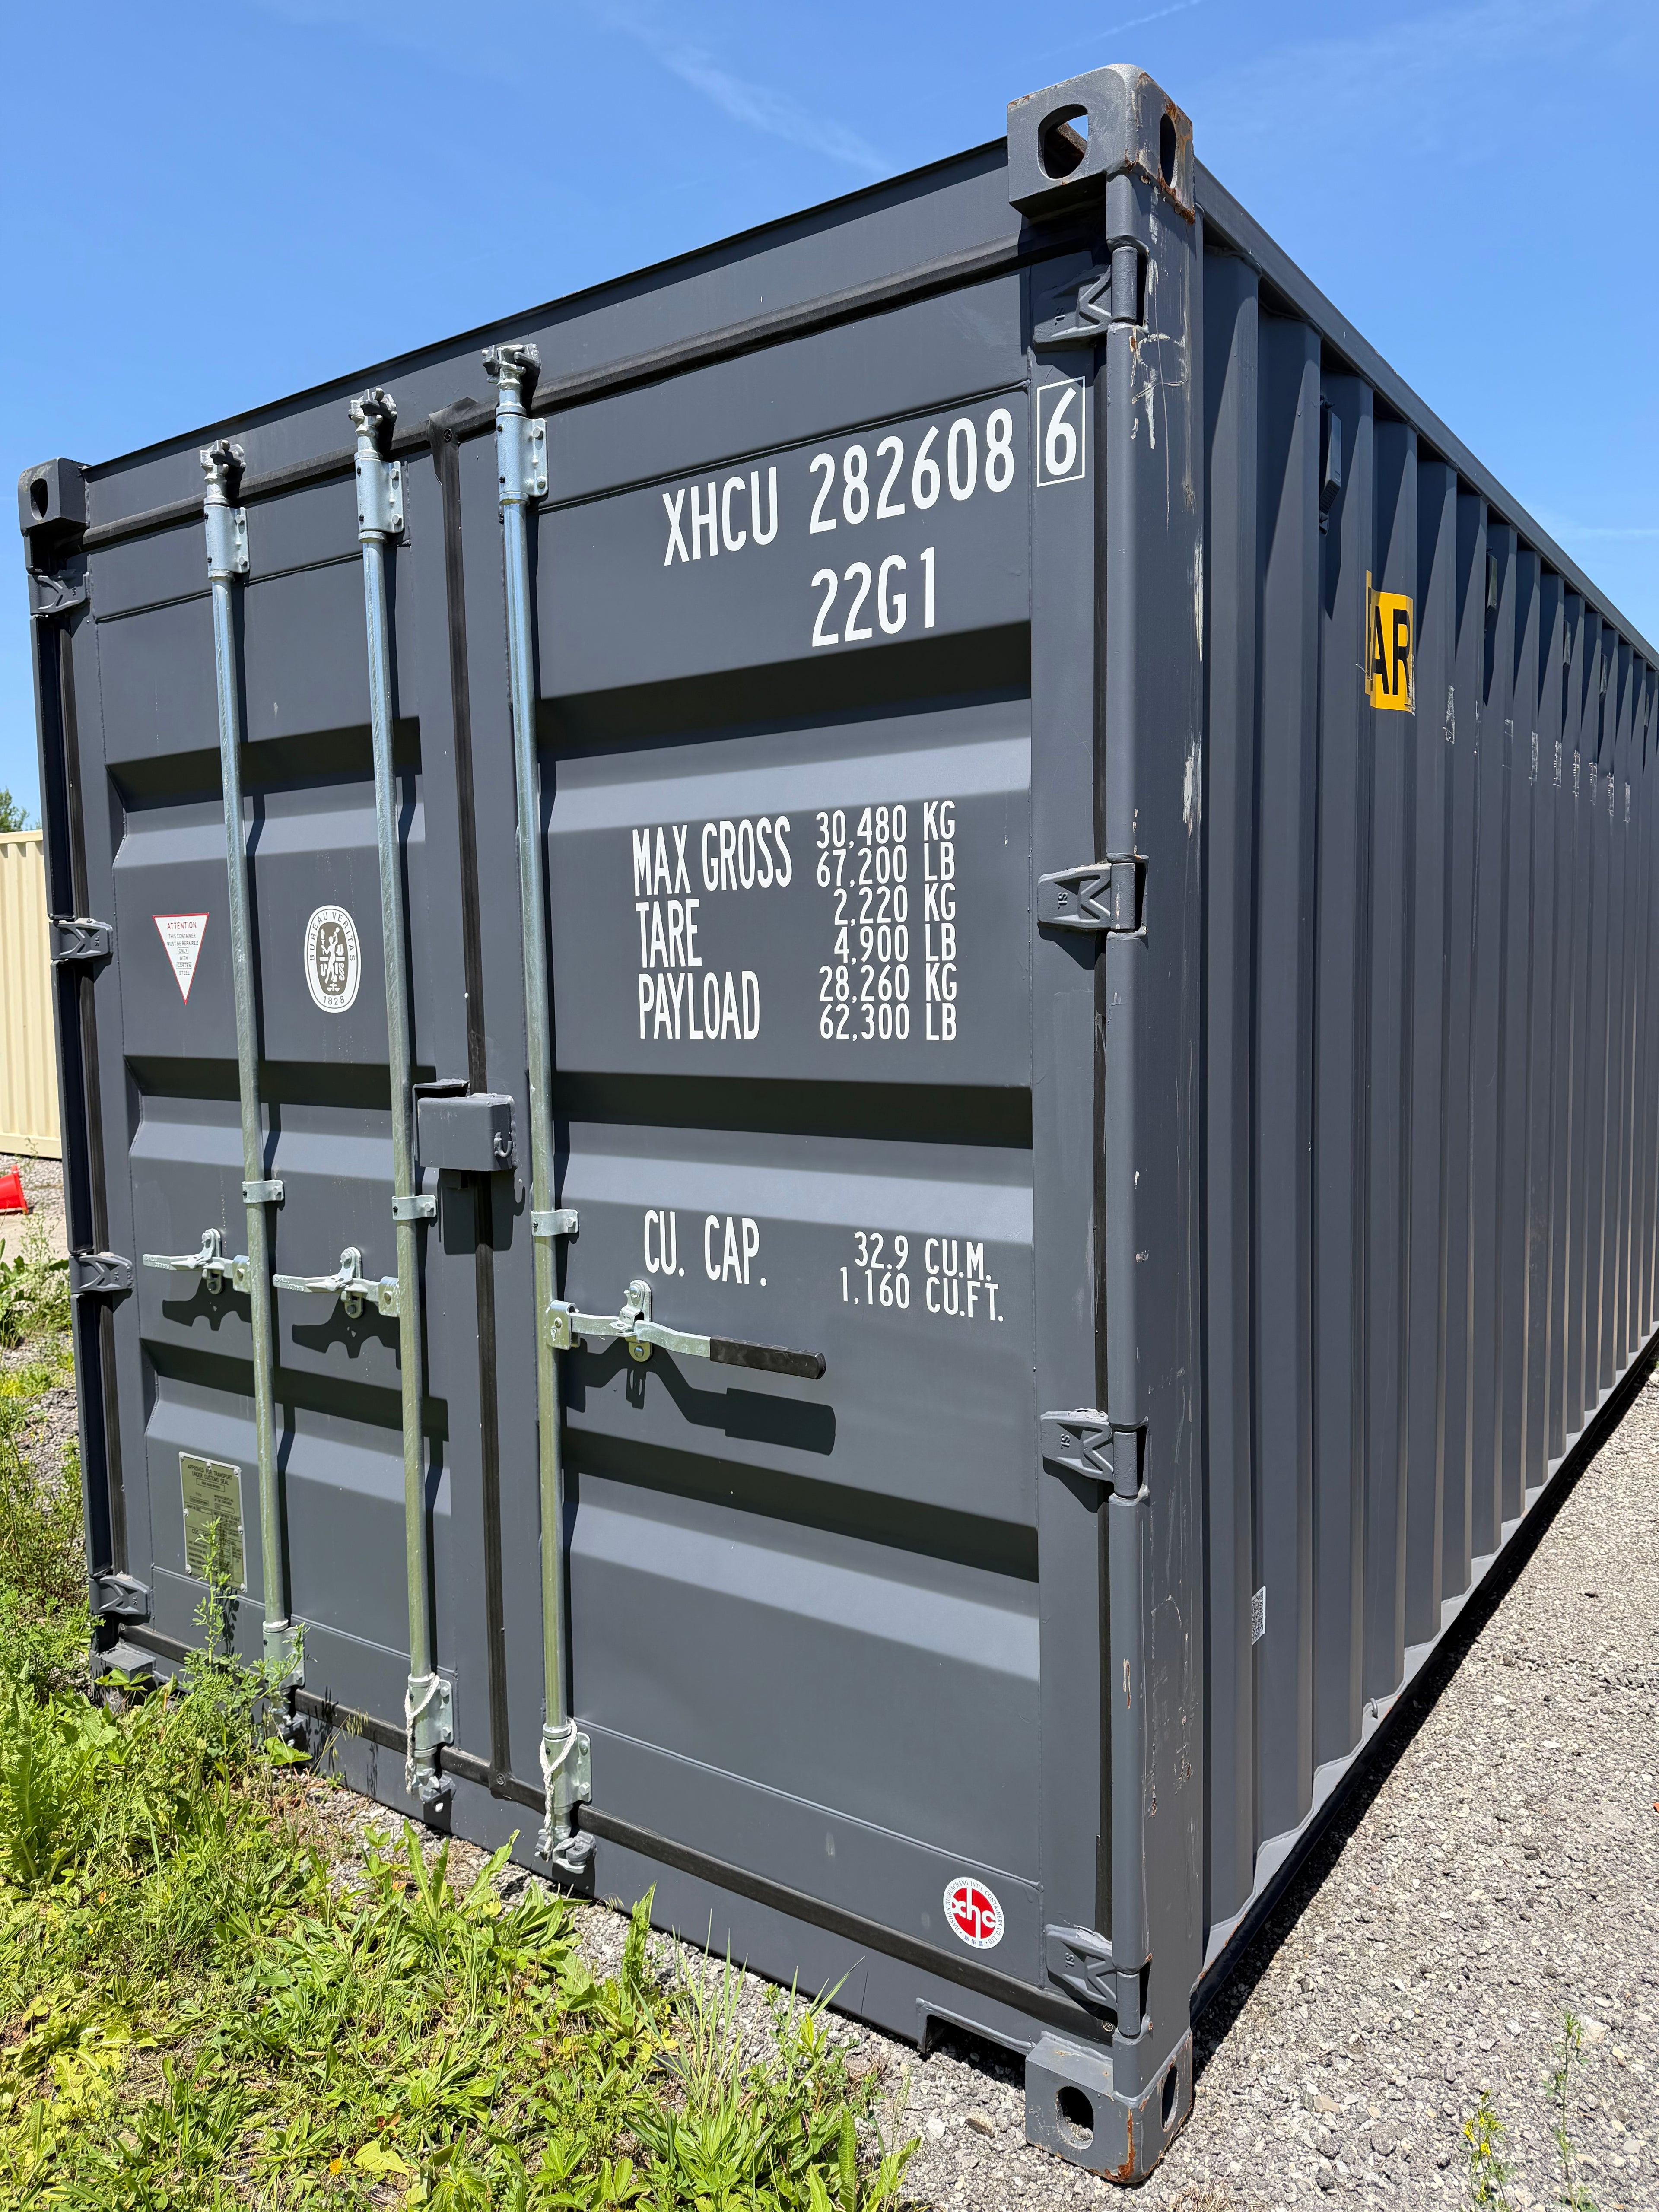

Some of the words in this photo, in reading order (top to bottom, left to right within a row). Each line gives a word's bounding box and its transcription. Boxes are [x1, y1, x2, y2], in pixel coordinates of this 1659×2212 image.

[662, 466, 778, 566] XHCU
[810, 408, 1014, 534] 282608
[1045, 387, 1077, 476] 6
[811, 547, 934, 647] 22G1
[1367, 587, 1411, 698] AR
[632, 824, 691, 896] MAX
[702, 815, 792, 891] GROSS
[816, 804, 907, 849] 30,480
[924, 800, 955, 841] KG
[817, 845, 907, 887] 67,200
[924, 841, 955, 881] LB
[310, 912, 328, 961] BUREAU
[332, 912, 355, 961] VERITAS
[636, 899, 702, 968] TARE
[833, 885, 908, 926] 2,220
[924, 882, 956, 922] KG
[834, 925, 909, 965] 4,900
[925, 923, 956, 961] LB
[324, 996, 345, 1005] 1828
[638, 971, 760, 1039] PAYLOAD
[819, 964, 909, 1003] 28,260
[925, 963, 957, 1001] KG
[820, 1003, 909, 1041] 62,300
[926, 1003, 957, 1041] LB
[644, 1209, 685, 1277] CU.
[705, 1215, 766, 1287] CAP.
[854, 1231, 908, 1271] 32.9
[925, 1238, 992, 1281] CU.M.
[840, 1266, 910, 1309] 1,160
[926, 1276, 1004, 1322] CU.FT.
[985, 1891, 1002, 1926] CONTAINERS
